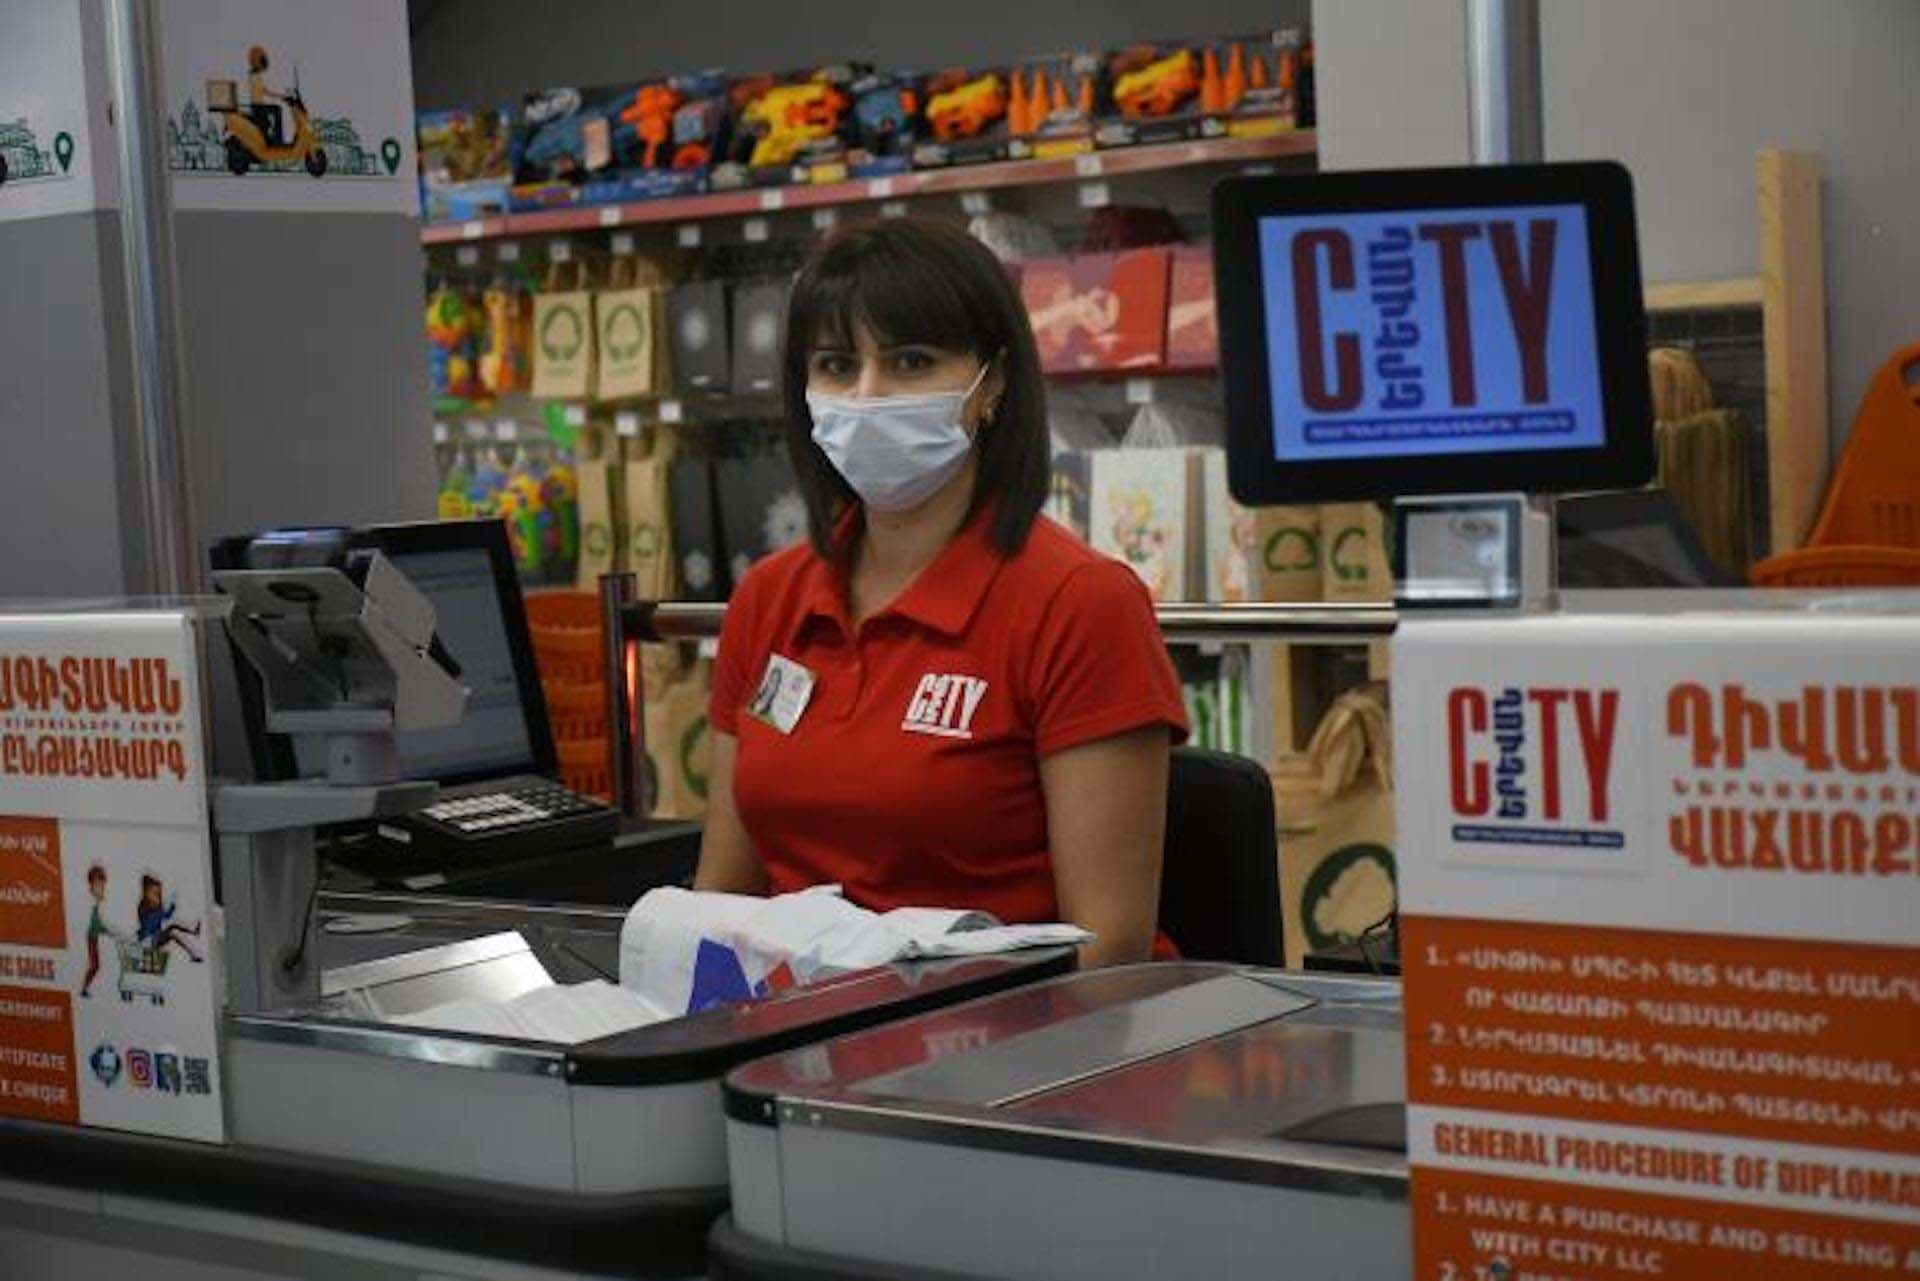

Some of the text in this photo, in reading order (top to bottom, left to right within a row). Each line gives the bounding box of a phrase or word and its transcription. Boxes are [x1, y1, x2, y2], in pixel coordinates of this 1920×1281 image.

[1668, 805, 1920, 878] ՎԱՃԱՌՔ
[17, 957, 55, 981] SALES
[1426, 945, 1449, 967] 1.
[1430, 1064, 1453, 1087] 3.
[1434, 1122, 1549, 1167] GENERAL
[1556, 1135, 1724, 1186] PROCEDURE
[1733, 1154, 1768, 1190] OF
[1436, 1191, 1457, 1213] 1.
[1465, 1194, 1532, 1223] HAVE
[1538, 1205, 1557, 1225] A
[1562, 1206, 1699, 1245] PURCHASE
[1709, 1224, 1768, 1251] AND
[1776, 1232, 1896, 1269] SELLING
[1471, 1228, 1664, 1274] WITH CITY LLC
